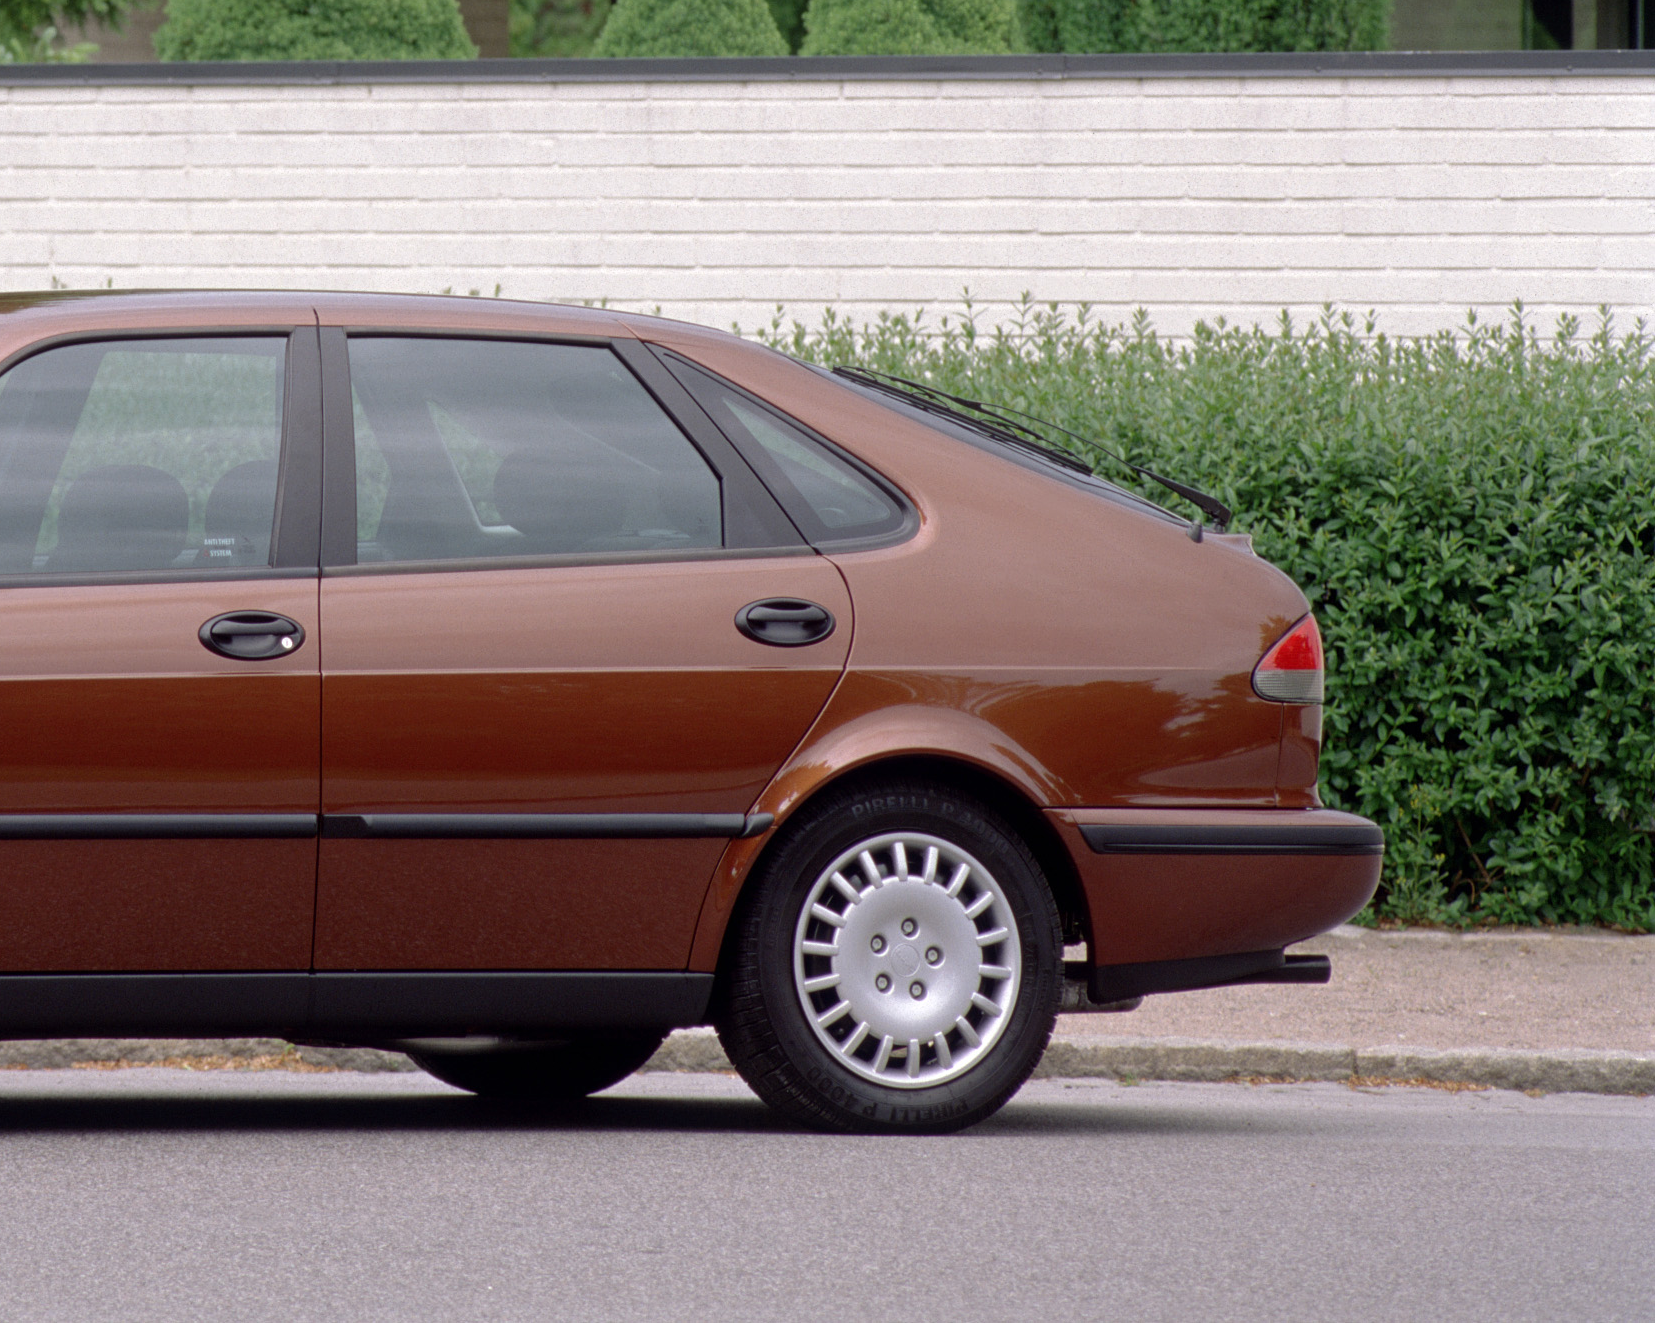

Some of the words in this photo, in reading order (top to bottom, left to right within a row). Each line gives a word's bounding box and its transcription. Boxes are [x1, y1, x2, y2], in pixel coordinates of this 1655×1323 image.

[210, 549, 232, 557] SYSTEM
[851, 794, 930, 819] PIRELLI
[940, 801, 955, 815] P
[806, 1065, 859, 1110] 4000
[862, 1101, 879, 1119] P
